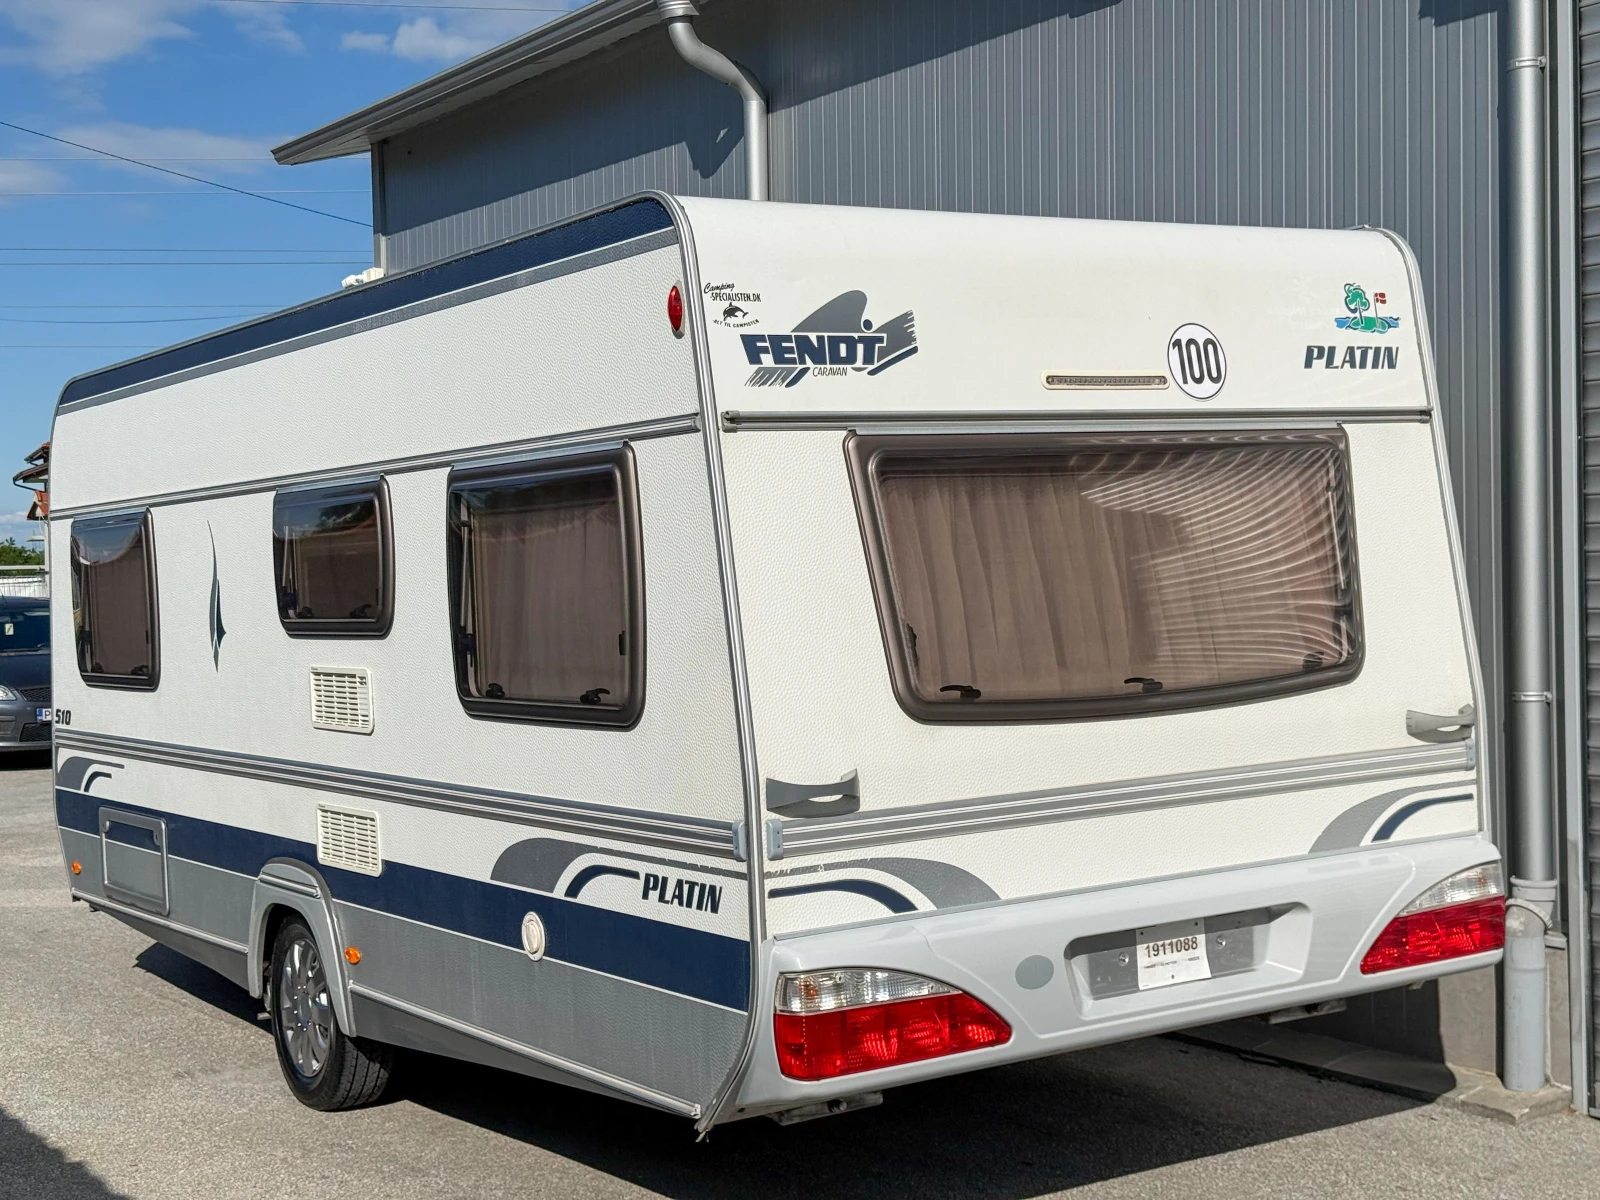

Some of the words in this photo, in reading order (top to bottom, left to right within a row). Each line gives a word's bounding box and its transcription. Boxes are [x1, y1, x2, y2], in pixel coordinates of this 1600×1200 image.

[704, 282, 735, 294] Camping
[740, 334, 885, 366] FENDT
[1172, 338, 1222, 385] 100
[1304, 345, 1399, 369] PLATIN
[812, 367, 848, 377] CARAVAN
[55, 708, 71, 725] 510
[642, 873, 722, 914] PLATIN
[1145, 936, 1198, 958] 1911088
